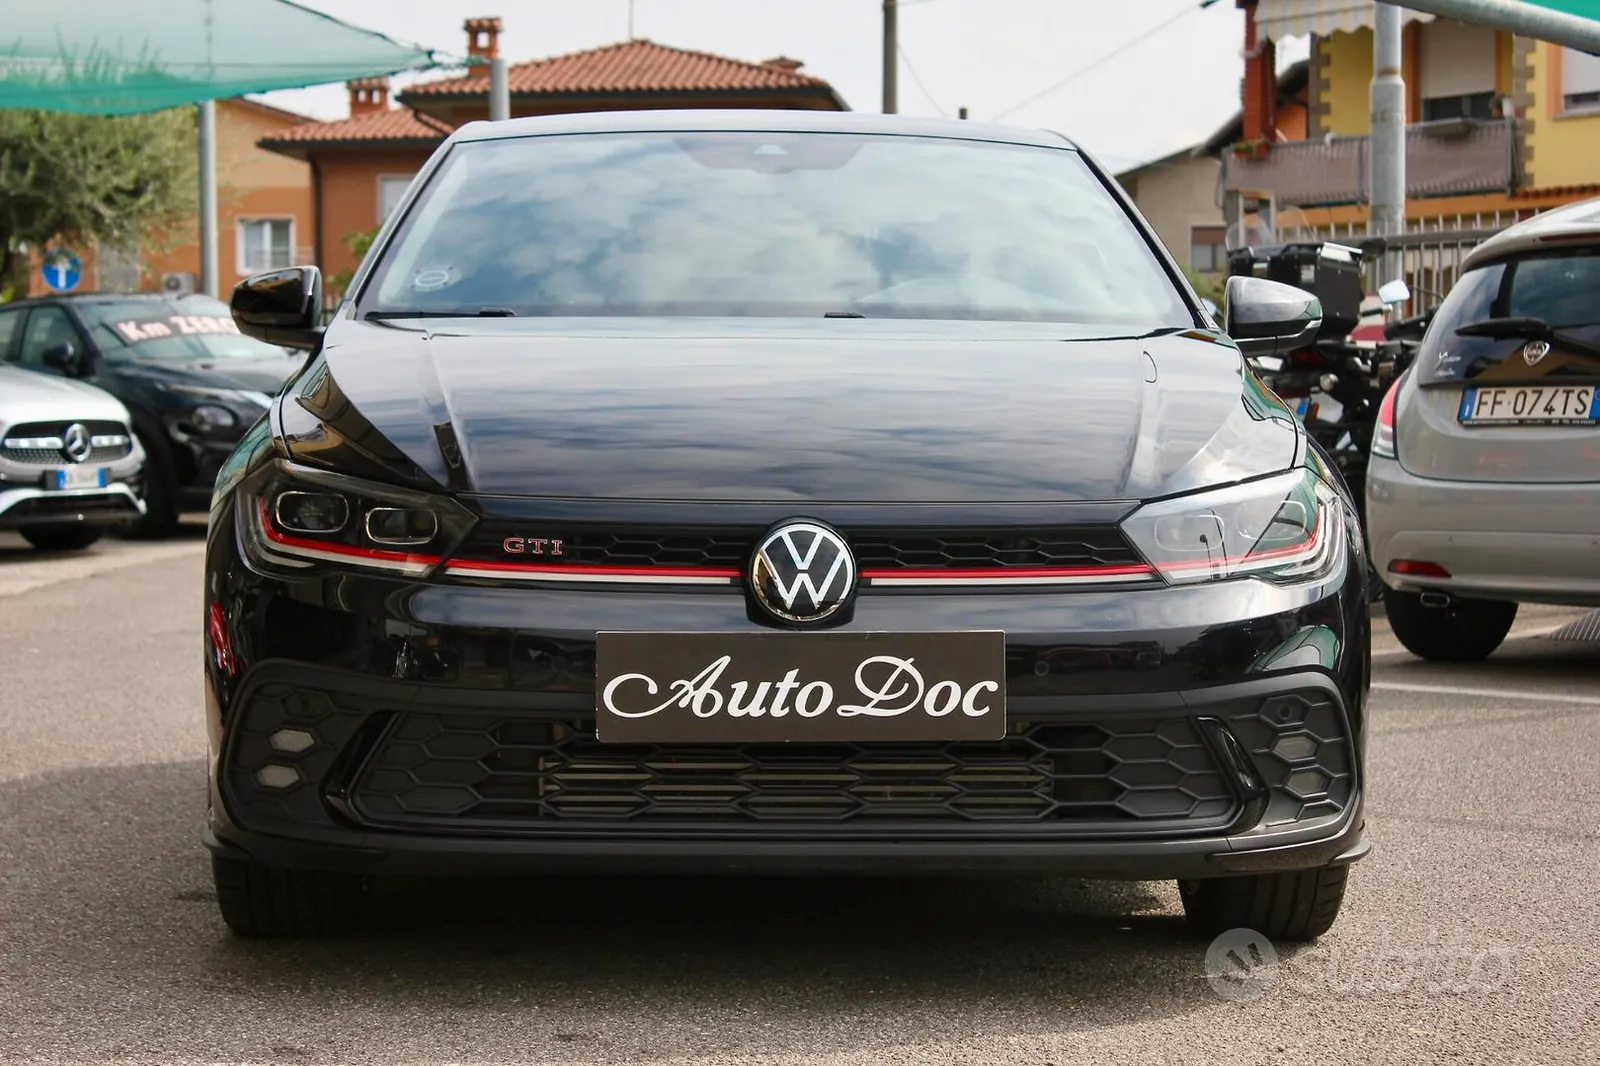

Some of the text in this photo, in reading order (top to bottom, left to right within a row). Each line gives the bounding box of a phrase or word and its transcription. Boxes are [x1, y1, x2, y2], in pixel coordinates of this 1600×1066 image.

[117, 320, 172, 342] Km
[503, 537, 563, 556] GTI
[602, 654, 999, 719] Auto Doc
